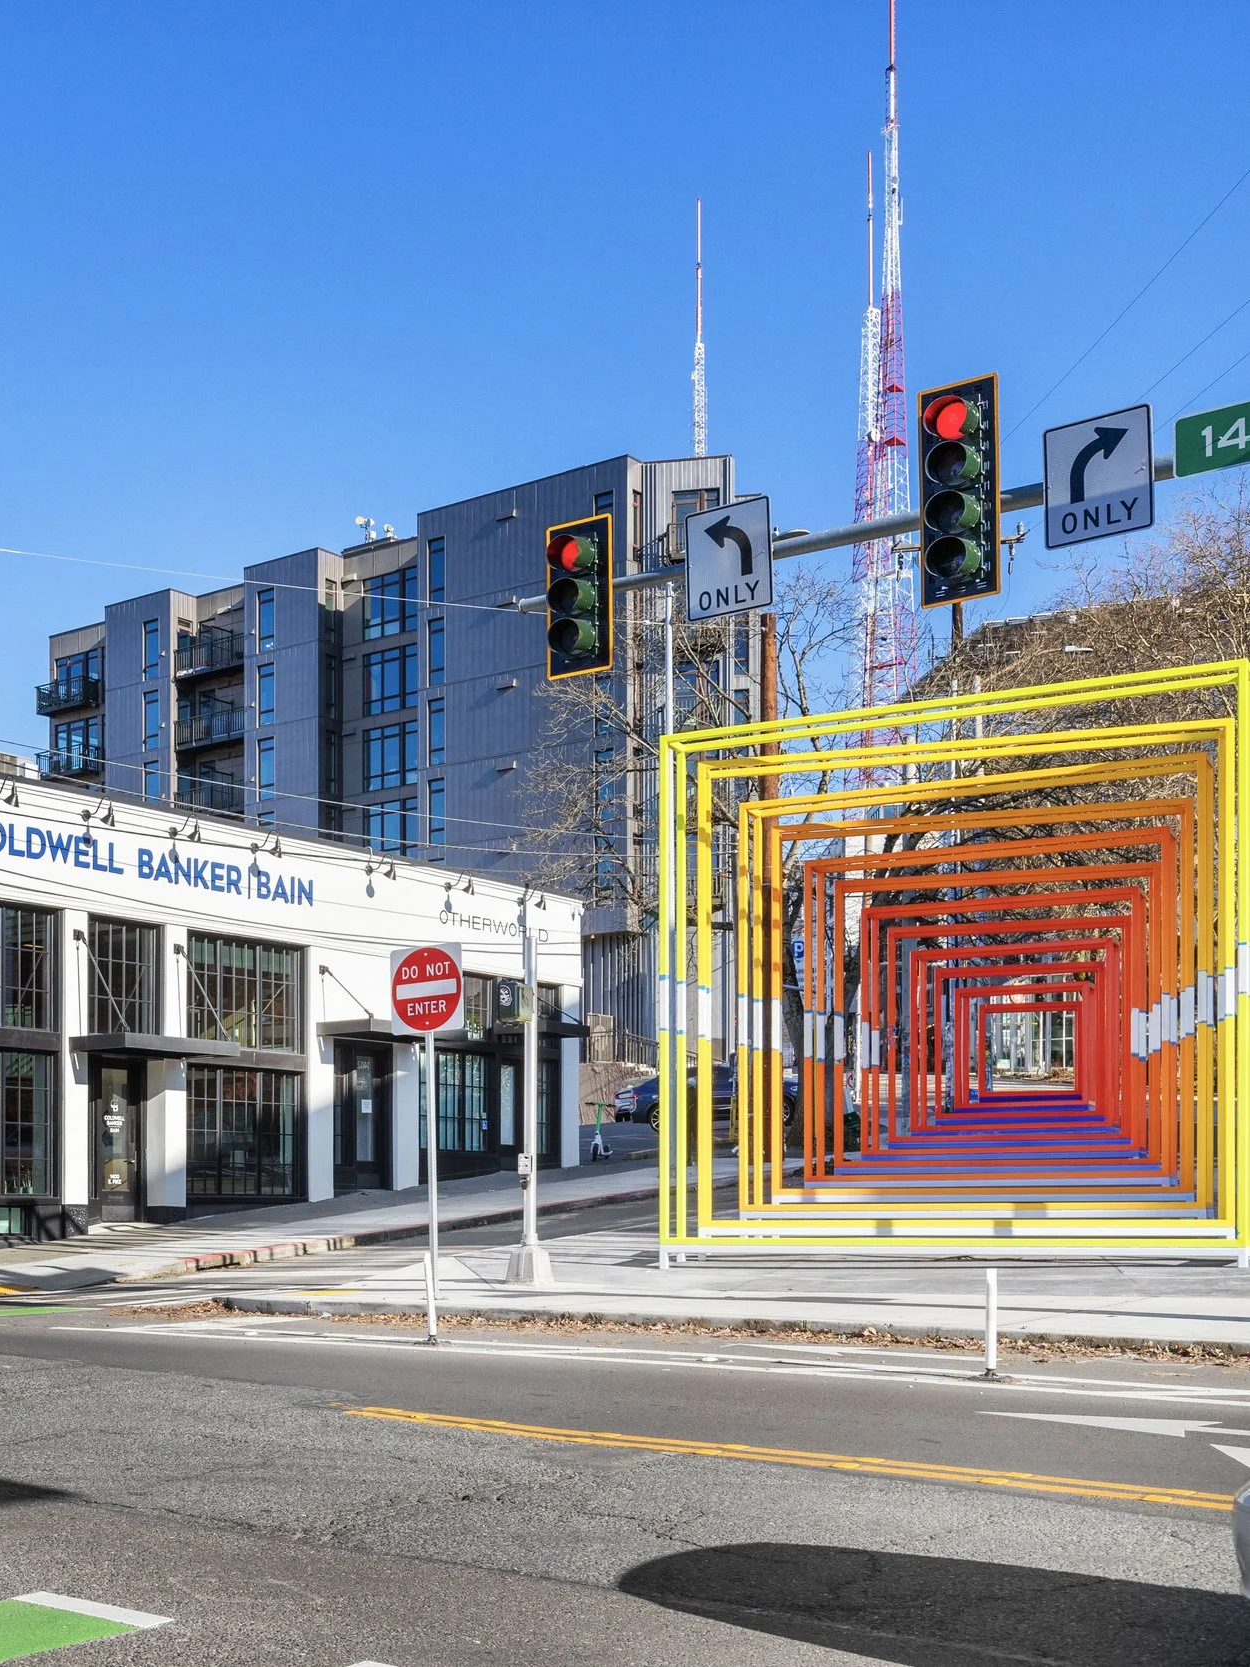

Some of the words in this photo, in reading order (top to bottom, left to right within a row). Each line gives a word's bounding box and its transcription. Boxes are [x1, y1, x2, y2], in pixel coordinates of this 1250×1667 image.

[1201, 417, 1250, 458] 14
[1061, 496, 1139, 535] ONLY
[699, 580, 760, 611] ONLY
[137, 847, 243, 896] BANKER
[256, 869, 314, 908] BAIN
[401, 965, 419, 980] DO
[426, 961, 451, 978] NOT
[407, 999, 447, 1017] ENTER
